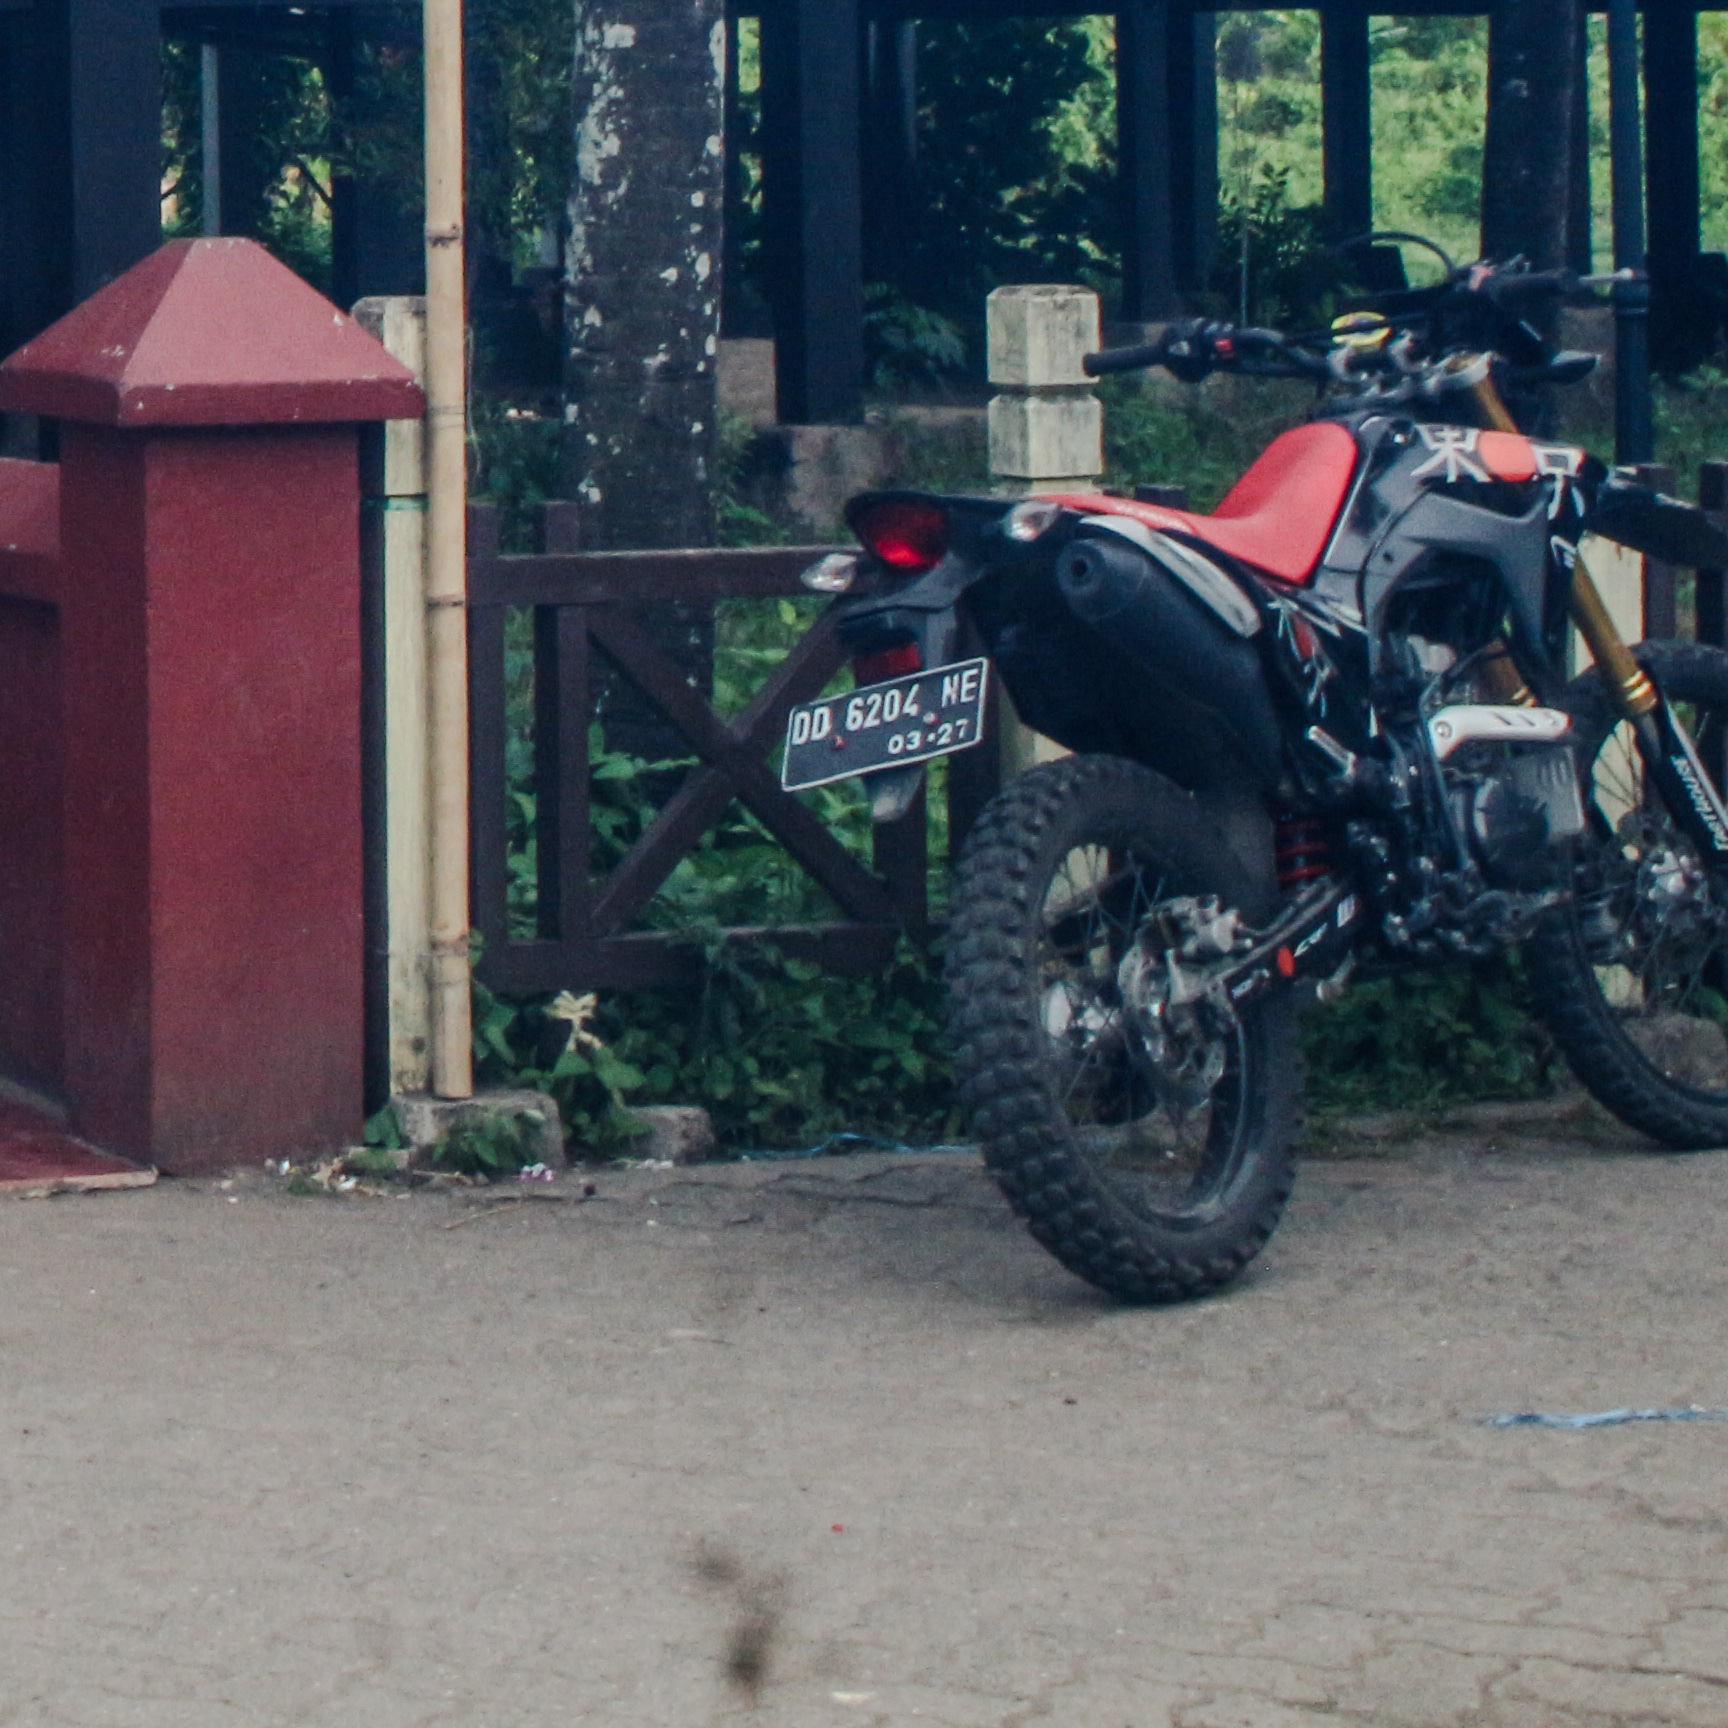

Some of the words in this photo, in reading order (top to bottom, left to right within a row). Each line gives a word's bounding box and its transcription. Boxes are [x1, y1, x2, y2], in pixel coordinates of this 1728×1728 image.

[791, 706, 832, 745] DD
[845, 683, 920, 731] 6204
[941, 668, 979, 708] NE
